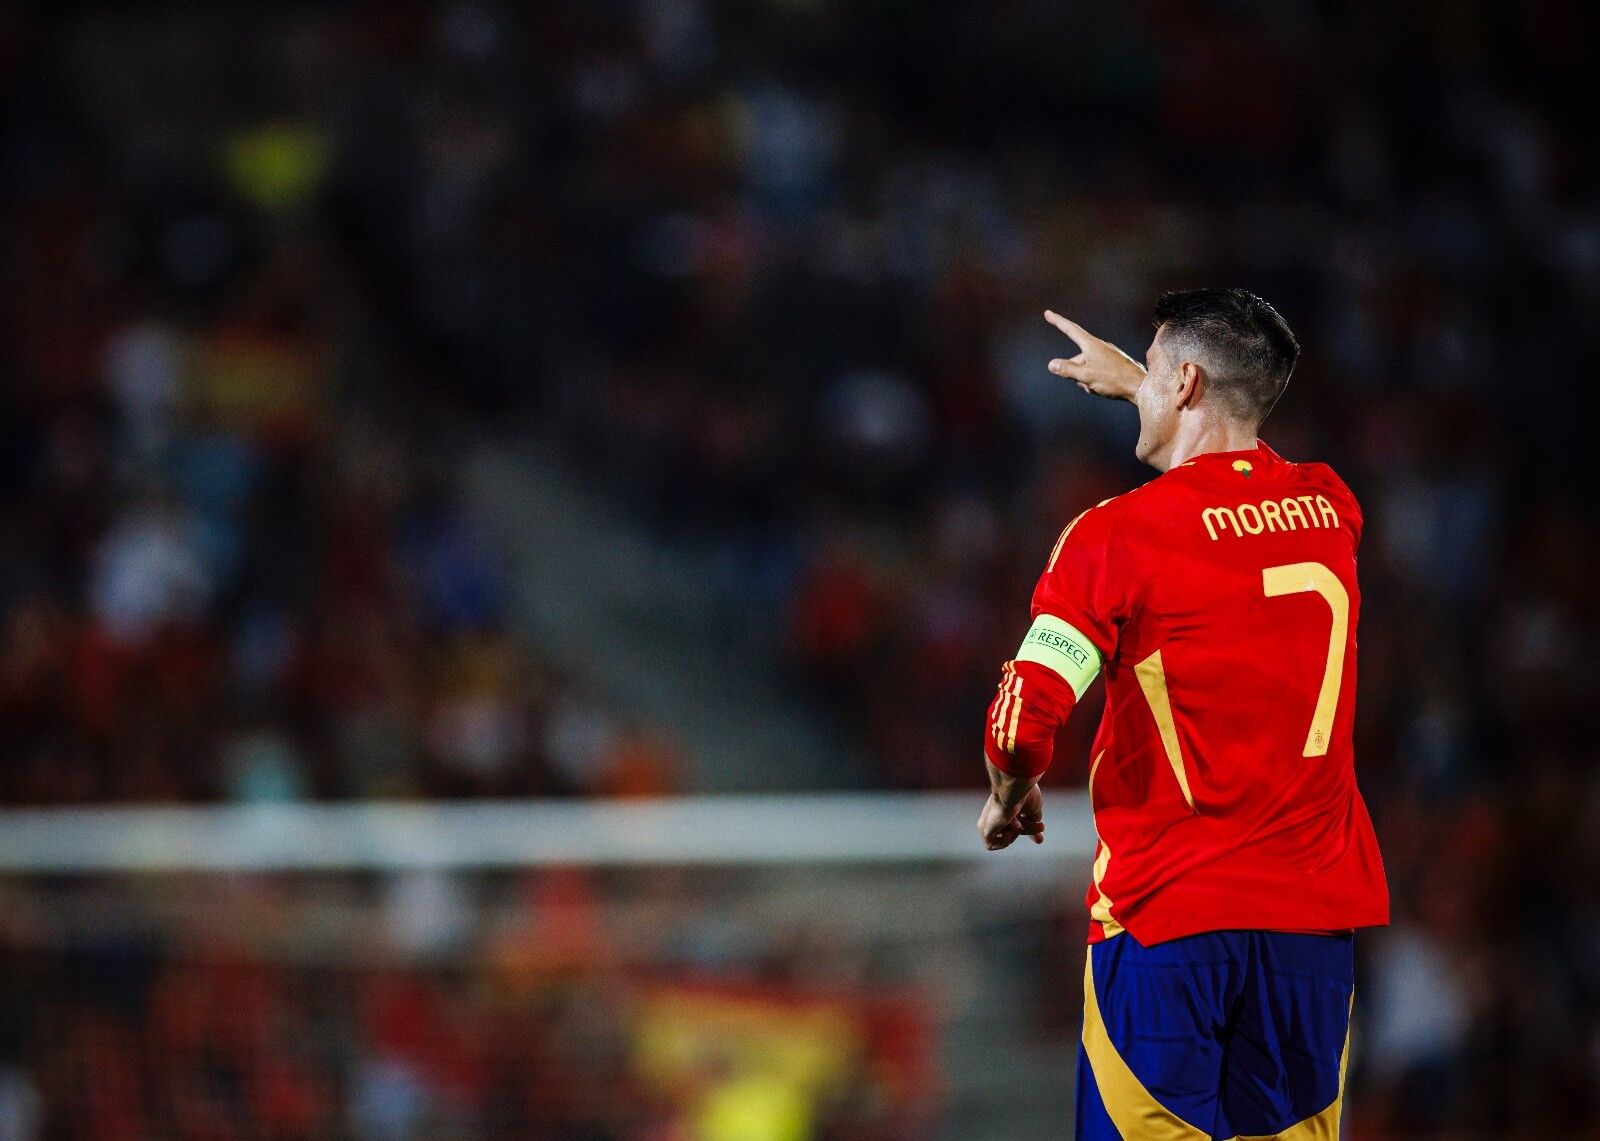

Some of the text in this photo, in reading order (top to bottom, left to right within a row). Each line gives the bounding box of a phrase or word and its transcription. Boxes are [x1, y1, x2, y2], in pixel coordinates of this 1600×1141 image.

[1202, 495, 1340, 541] MORATA
[1037, 631, 1088, 664] RESPECT
[1262, 561, 1350, 757] 7
